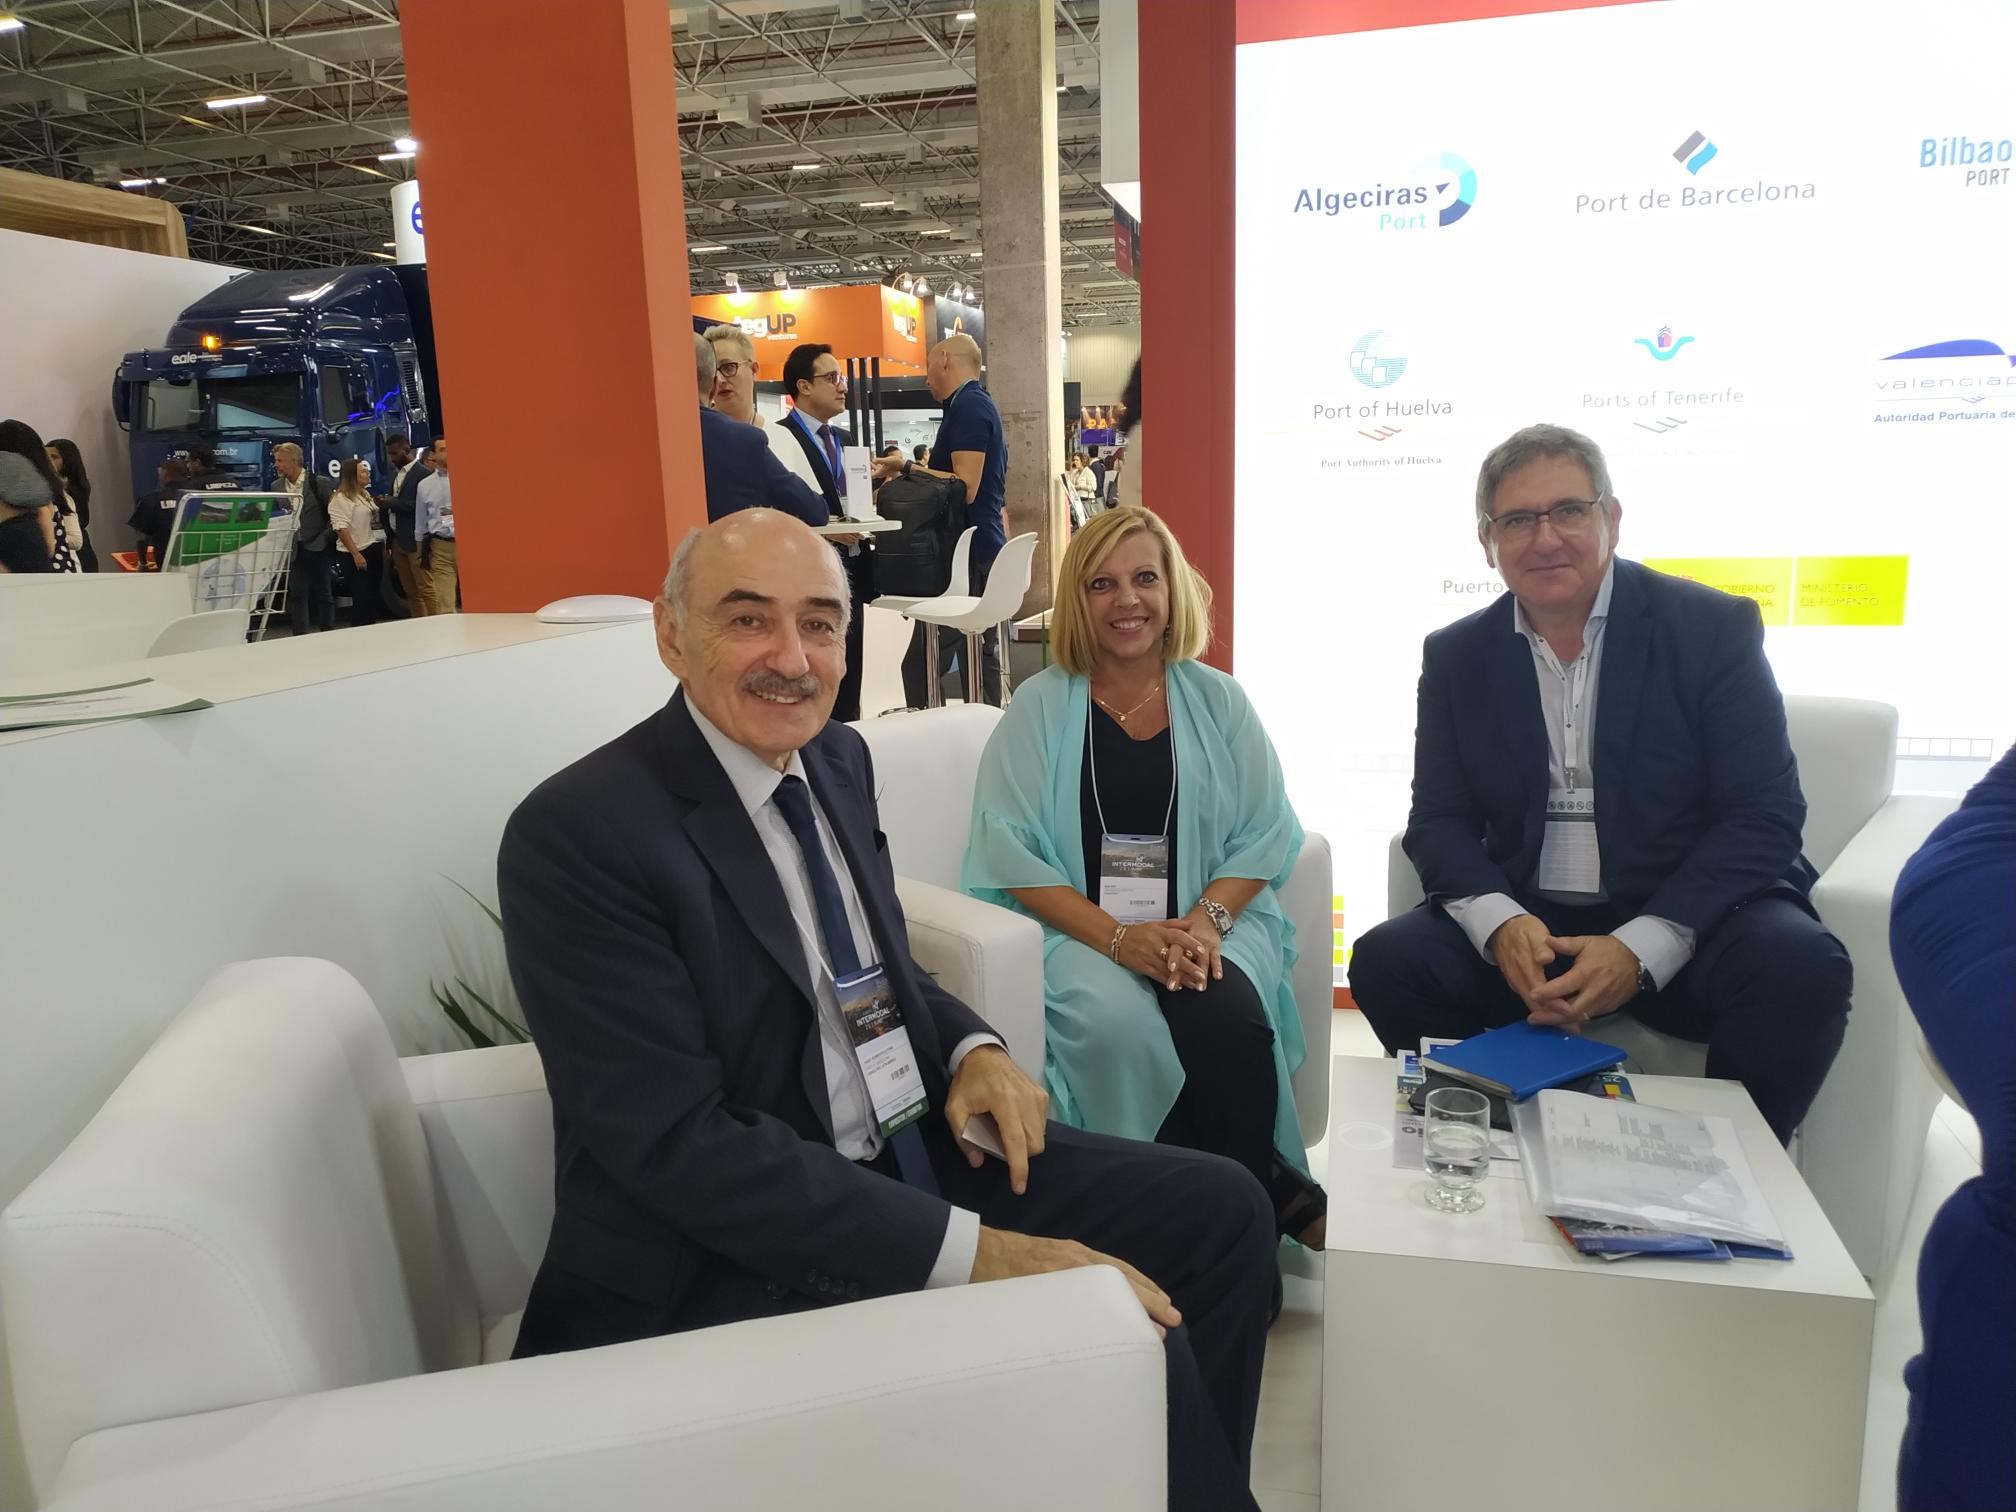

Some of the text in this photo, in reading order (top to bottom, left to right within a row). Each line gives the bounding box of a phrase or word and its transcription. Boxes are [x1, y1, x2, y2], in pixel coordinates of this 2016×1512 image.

[1920, 136, 2012, 168] Bilbao
[1966, 168, 2010, 187] PORT
[1294, 183, 1428, 216] Algeciras
[1576, 181, 1816, 214] Port de Barcelona
[1379, 213, 1426, 231] Port
[171, 352, 198, 365] eale
[1582, 387, 1744, 408] Ports of Tenerife
[1314, 399, 1453, 420] Port of Huelva
[1874, 410, 2016, 423] Autoridad Portuaria de
[1321, 455, 1443, 469] Port Authority of Huelva
[1443, 580, 1504, 593] Puerto
[1801, 583, 1868, 593] MINISTERIO
[1800, 597, 1816, 607] DE
